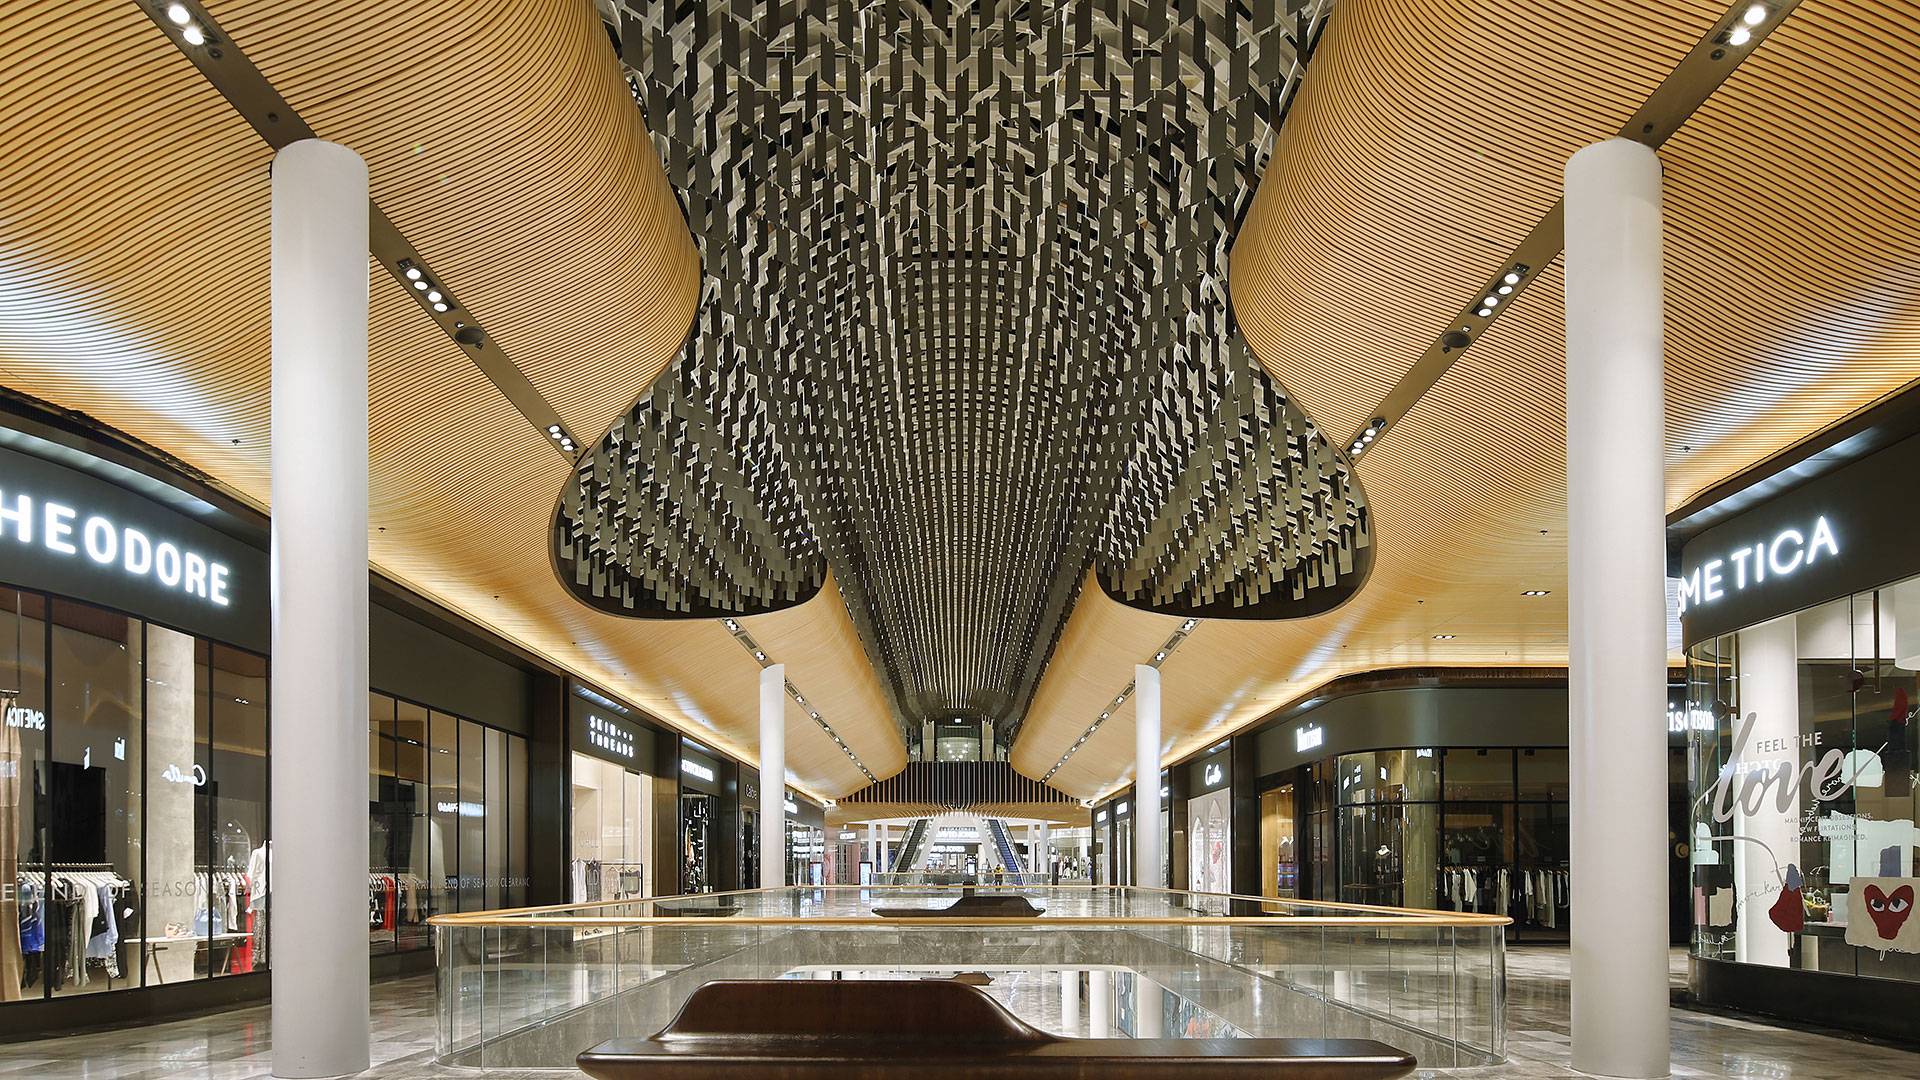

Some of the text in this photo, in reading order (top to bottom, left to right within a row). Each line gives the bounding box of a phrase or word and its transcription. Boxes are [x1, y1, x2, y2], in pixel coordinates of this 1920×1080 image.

[1756, 731, 1823, 755] FEEL THE
[1710, 710, 1888, 824] love
[139, 880, 209, 897] EASON
